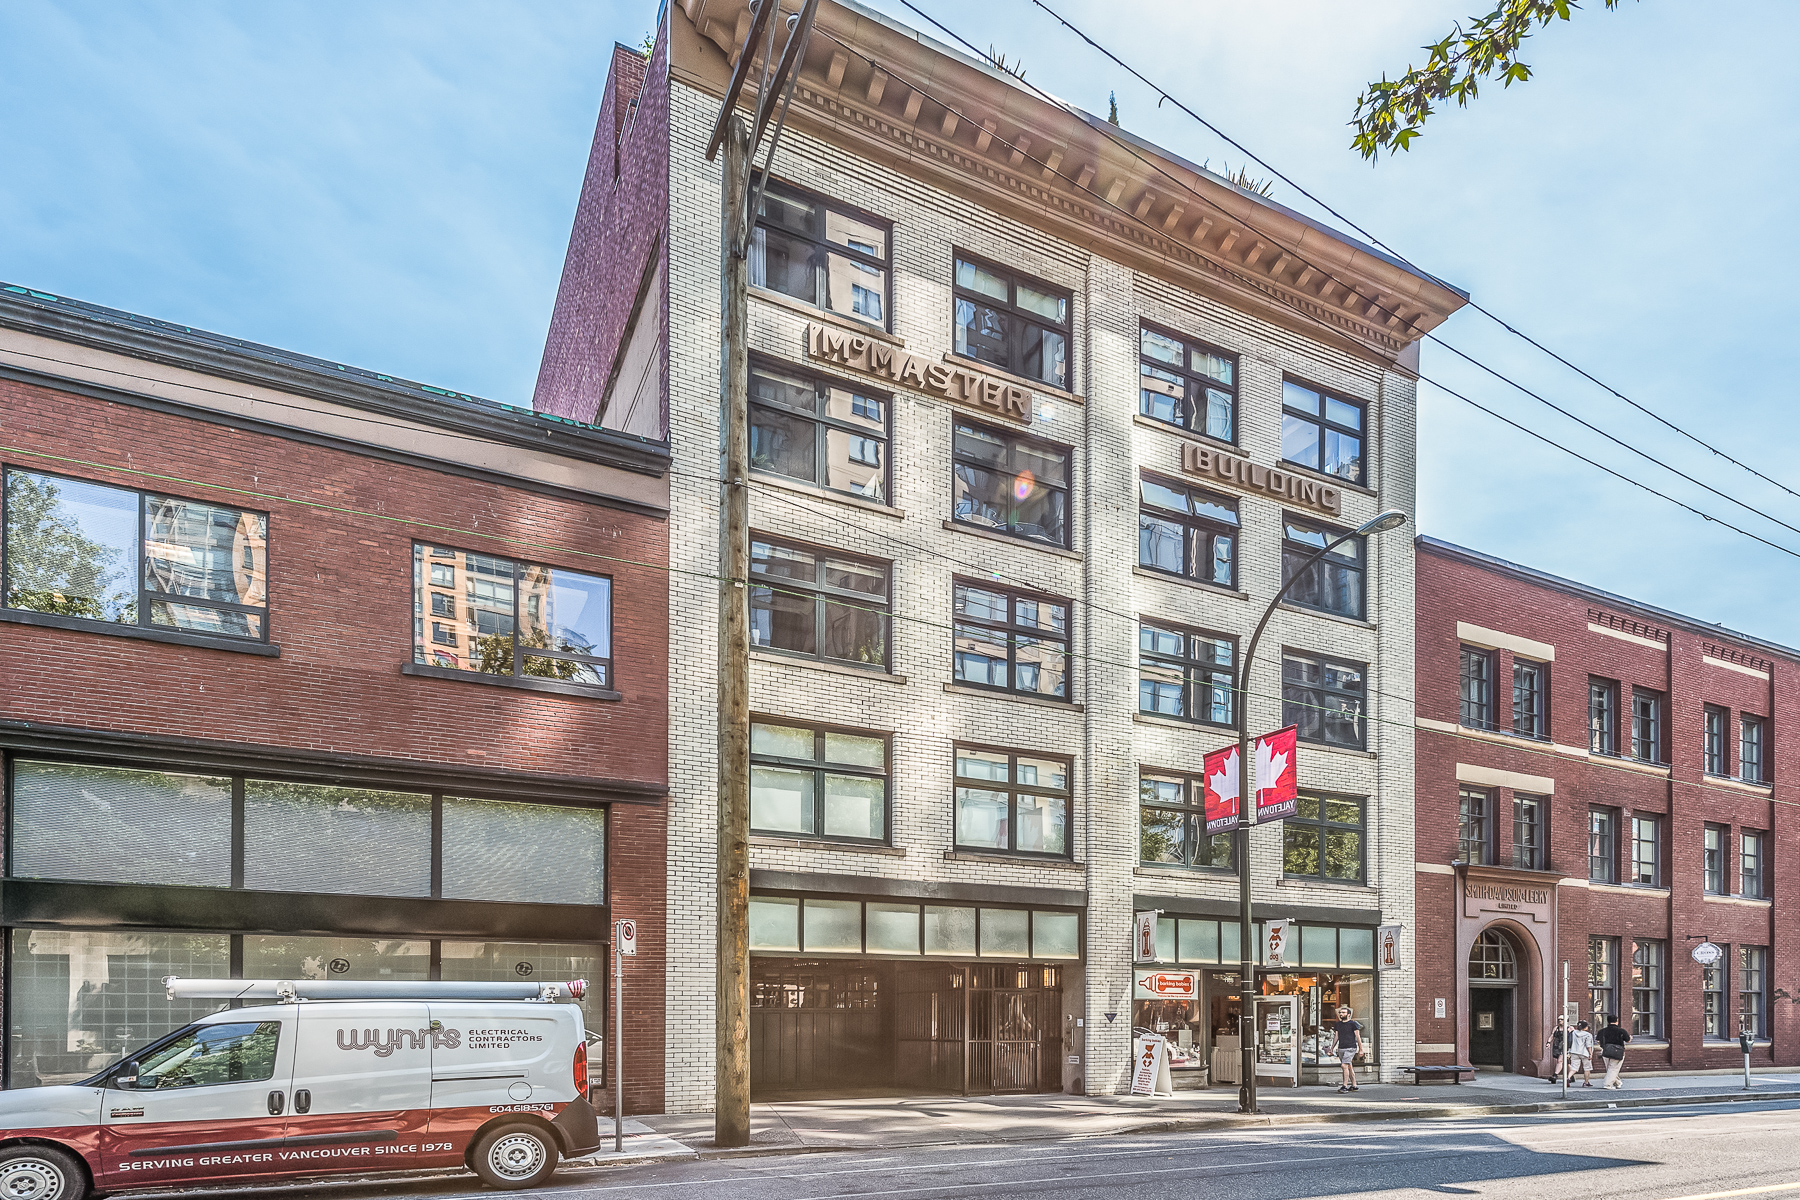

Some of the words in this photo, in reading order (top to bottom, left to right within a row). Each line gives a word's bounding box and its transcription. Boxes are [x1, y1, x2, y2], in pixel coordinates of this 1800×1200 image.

[118, 1158, 194, 1172] SERVING
[199, 1152, 273, 1166] GREATER
[279, 1147, 370, 1160] VANCOUVER
[375, 1144, 417, 1155] SINCE
[421, 1142, 453, 1152] 1978
